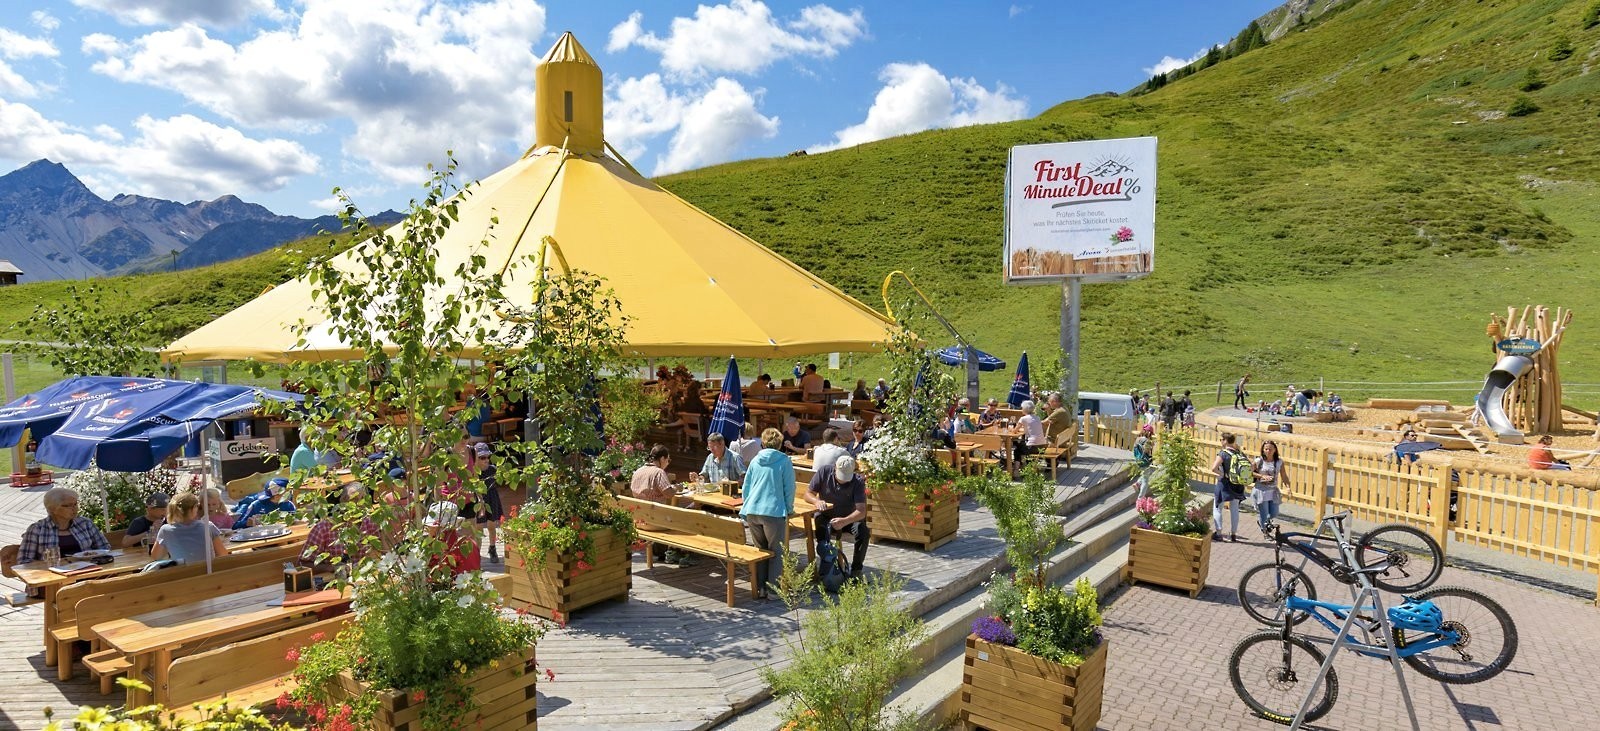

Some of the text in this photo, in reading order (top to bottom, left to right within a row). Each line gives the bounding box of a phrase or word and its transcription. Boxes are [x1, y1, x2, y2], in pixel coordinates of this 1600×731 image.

[1034, 160, 1081, 182] First
[1023, 184, 1076, 199] Minute
[1074, 175, 1123, 197] Deal
[1055, 218, 1082, 226] nächstes
[1082, 217, 1108, 225] Skiticket
[1076, 249, 1102, 258] Arosa
